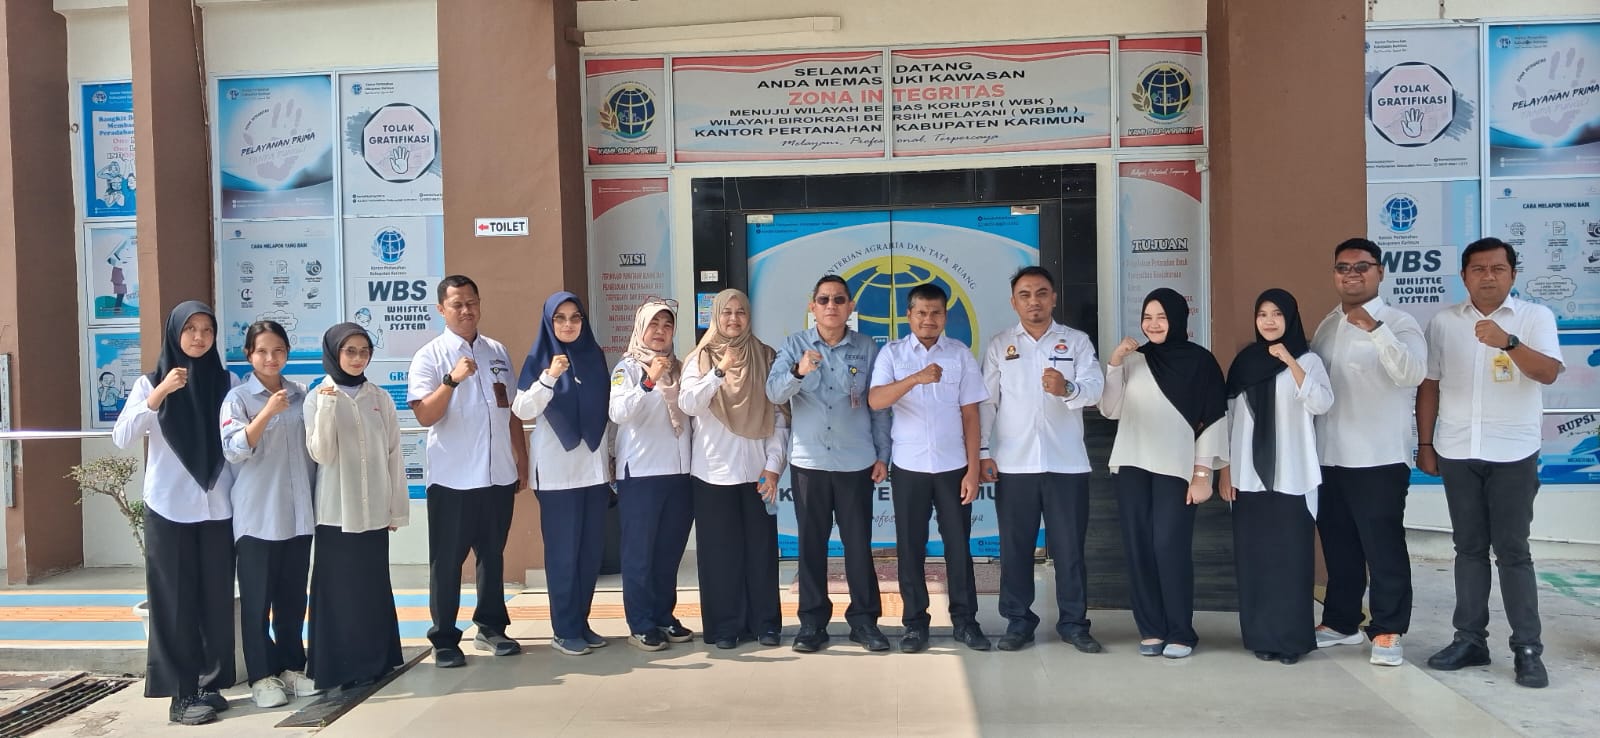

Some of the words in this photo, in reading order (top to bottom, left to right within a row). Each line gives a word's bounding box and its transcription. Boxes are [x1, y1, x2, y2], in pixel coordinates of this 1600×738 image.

[794, 66, 882, 77] SELAMAT
[896, 62, 973, 73] DATANG
[757, 79, 810, 88] ANDA
[929, 70, 1025, 82] KAWASAN
[1394, 84, 1430, 93] TOLAK
[788, 90, 853, 105] ZONA
[1377, 95, 1447, 106] GRATIFIKASI
[1511, 90, 1570, 110] PELAYANAN
[1572, 83, 1600, 97] PRIMA
[729, 108, 790, 116] MENUJU
[794, 106, 859, 115] WILAYAH
[928, 100, 995, 110] KORUPSI
[710, 118, 774, 126] WILAYAH
[778, 115, 859, 124] BIROKRASI
[932, 109, 1006, 119] MELAYANI
[382, 124, 415, 133] TOLAK
[695, 128, 764, 137] KANTOR
[768, 124, 882, 136] PERTANAHAN
[896, 119, 998, 132] KABUPATEN
[1004, 115, 1085, 126] KARIMUN
[240, 138, 290, 156] PELAYANAN
[291, 131, 316, 144] PRIMA
[368, 135, 430, 144] GRATIFIKASI
[489, 221, 526, 232] TOILET
[1132, 238, 1189, 252] TUJUAN
[619, 253, 647, 266] VISI
[906, 242, 927, 253] DAN
[928, 248, 950, 264] TATA
[951, 263, 977, 290] RUANG
[1395, 277, 1443, 285] WHISTLE
[368, 280, 428, 301] WBS
[1393, 286, 1446, 295] BLOWING
[1398, 295, 1440, 304] SYSTEM
[387, 305, 428, 313] WHISTLE
[384, 314, 432, 322] BLOWING
[389, 322, 426, 331] SYSTEM
